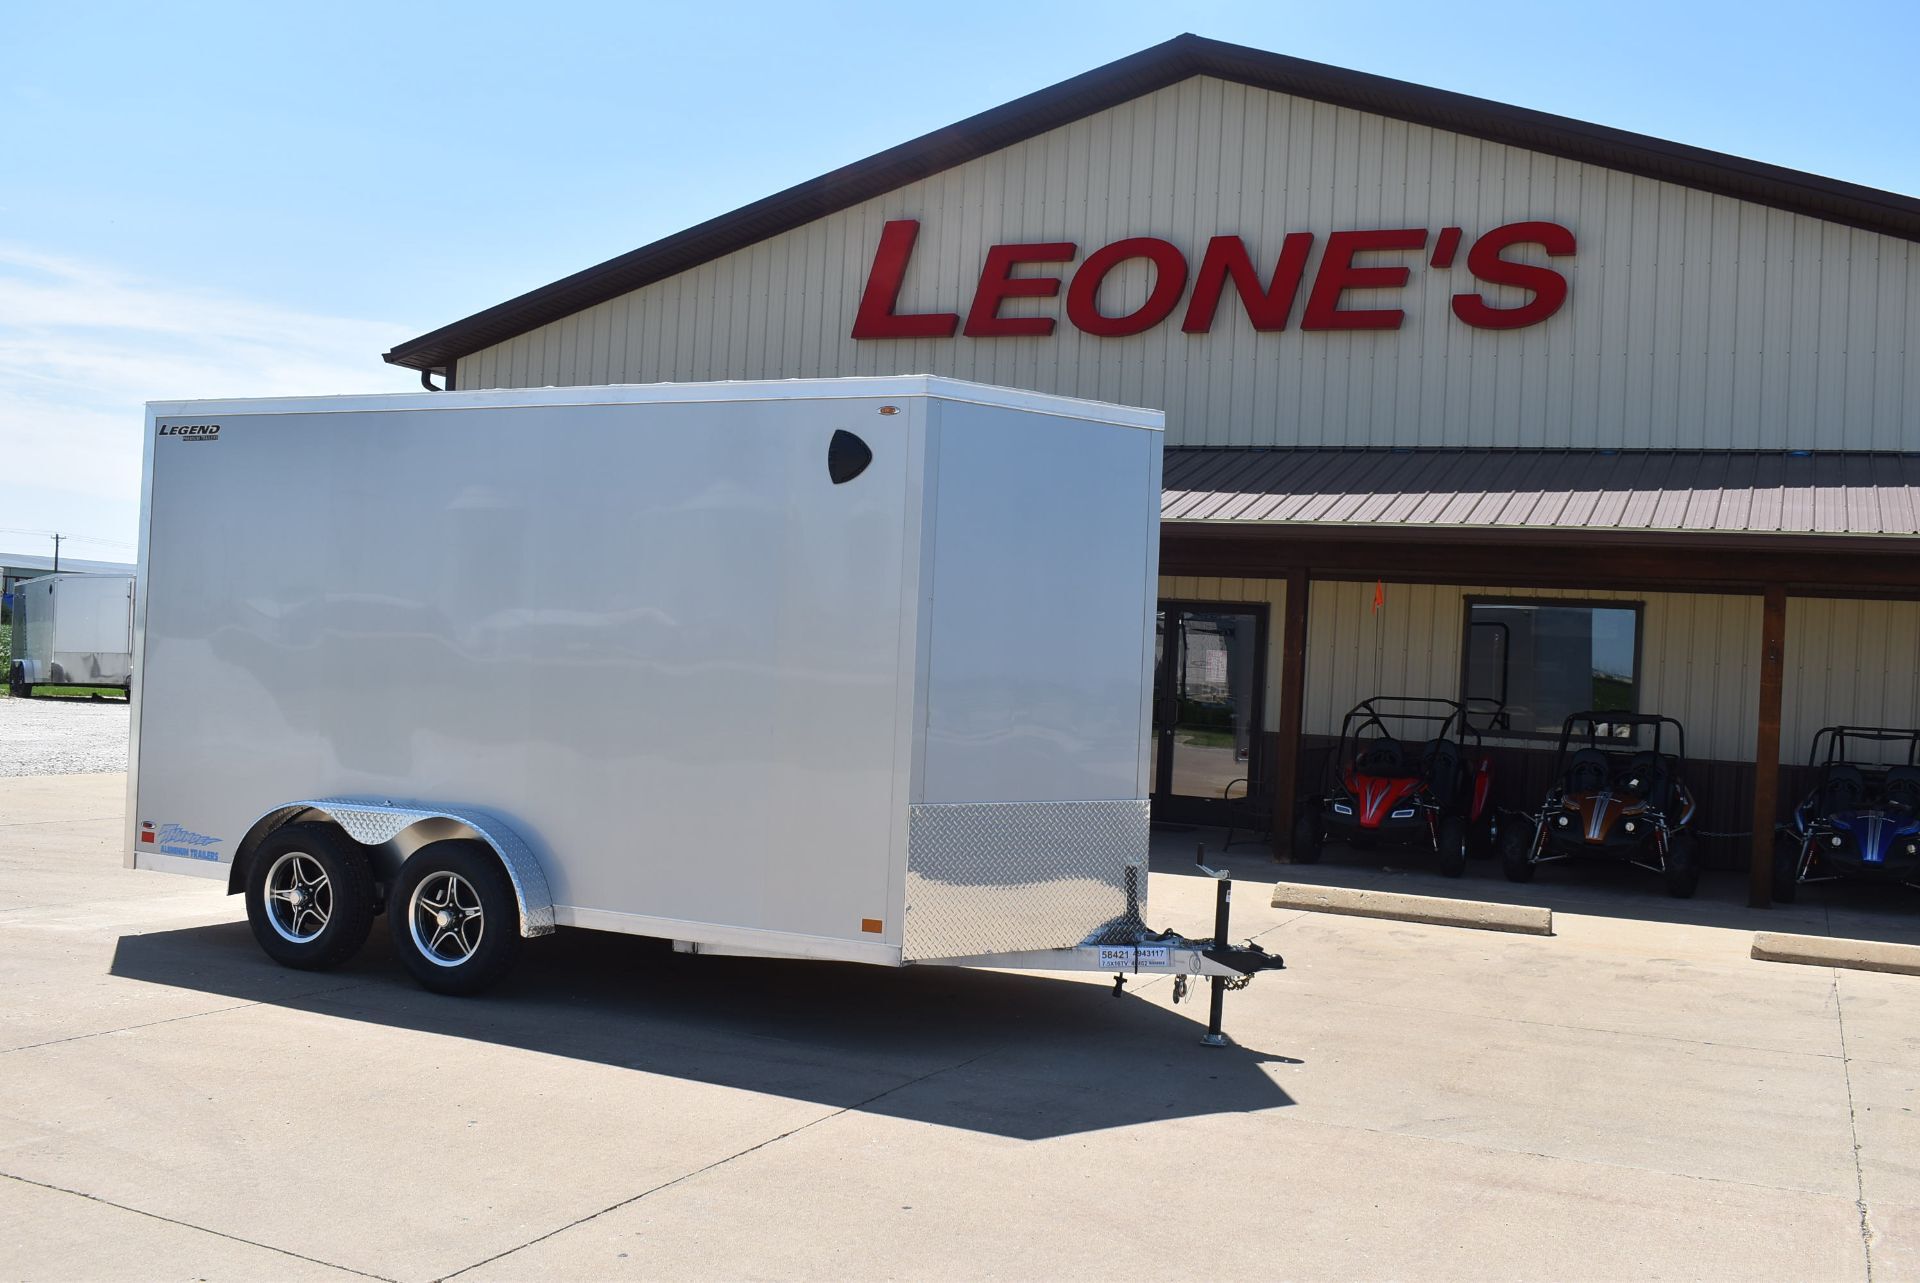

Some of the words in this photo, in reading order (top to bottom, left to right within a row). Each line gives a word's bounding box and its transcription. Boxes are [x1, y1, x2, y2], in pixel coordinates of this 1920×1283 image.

[851, 219, 1578, 340] LEONE'S
[158, 424, 221, 436] LEGEND
[1101, 950, 1129, 959] 58421
